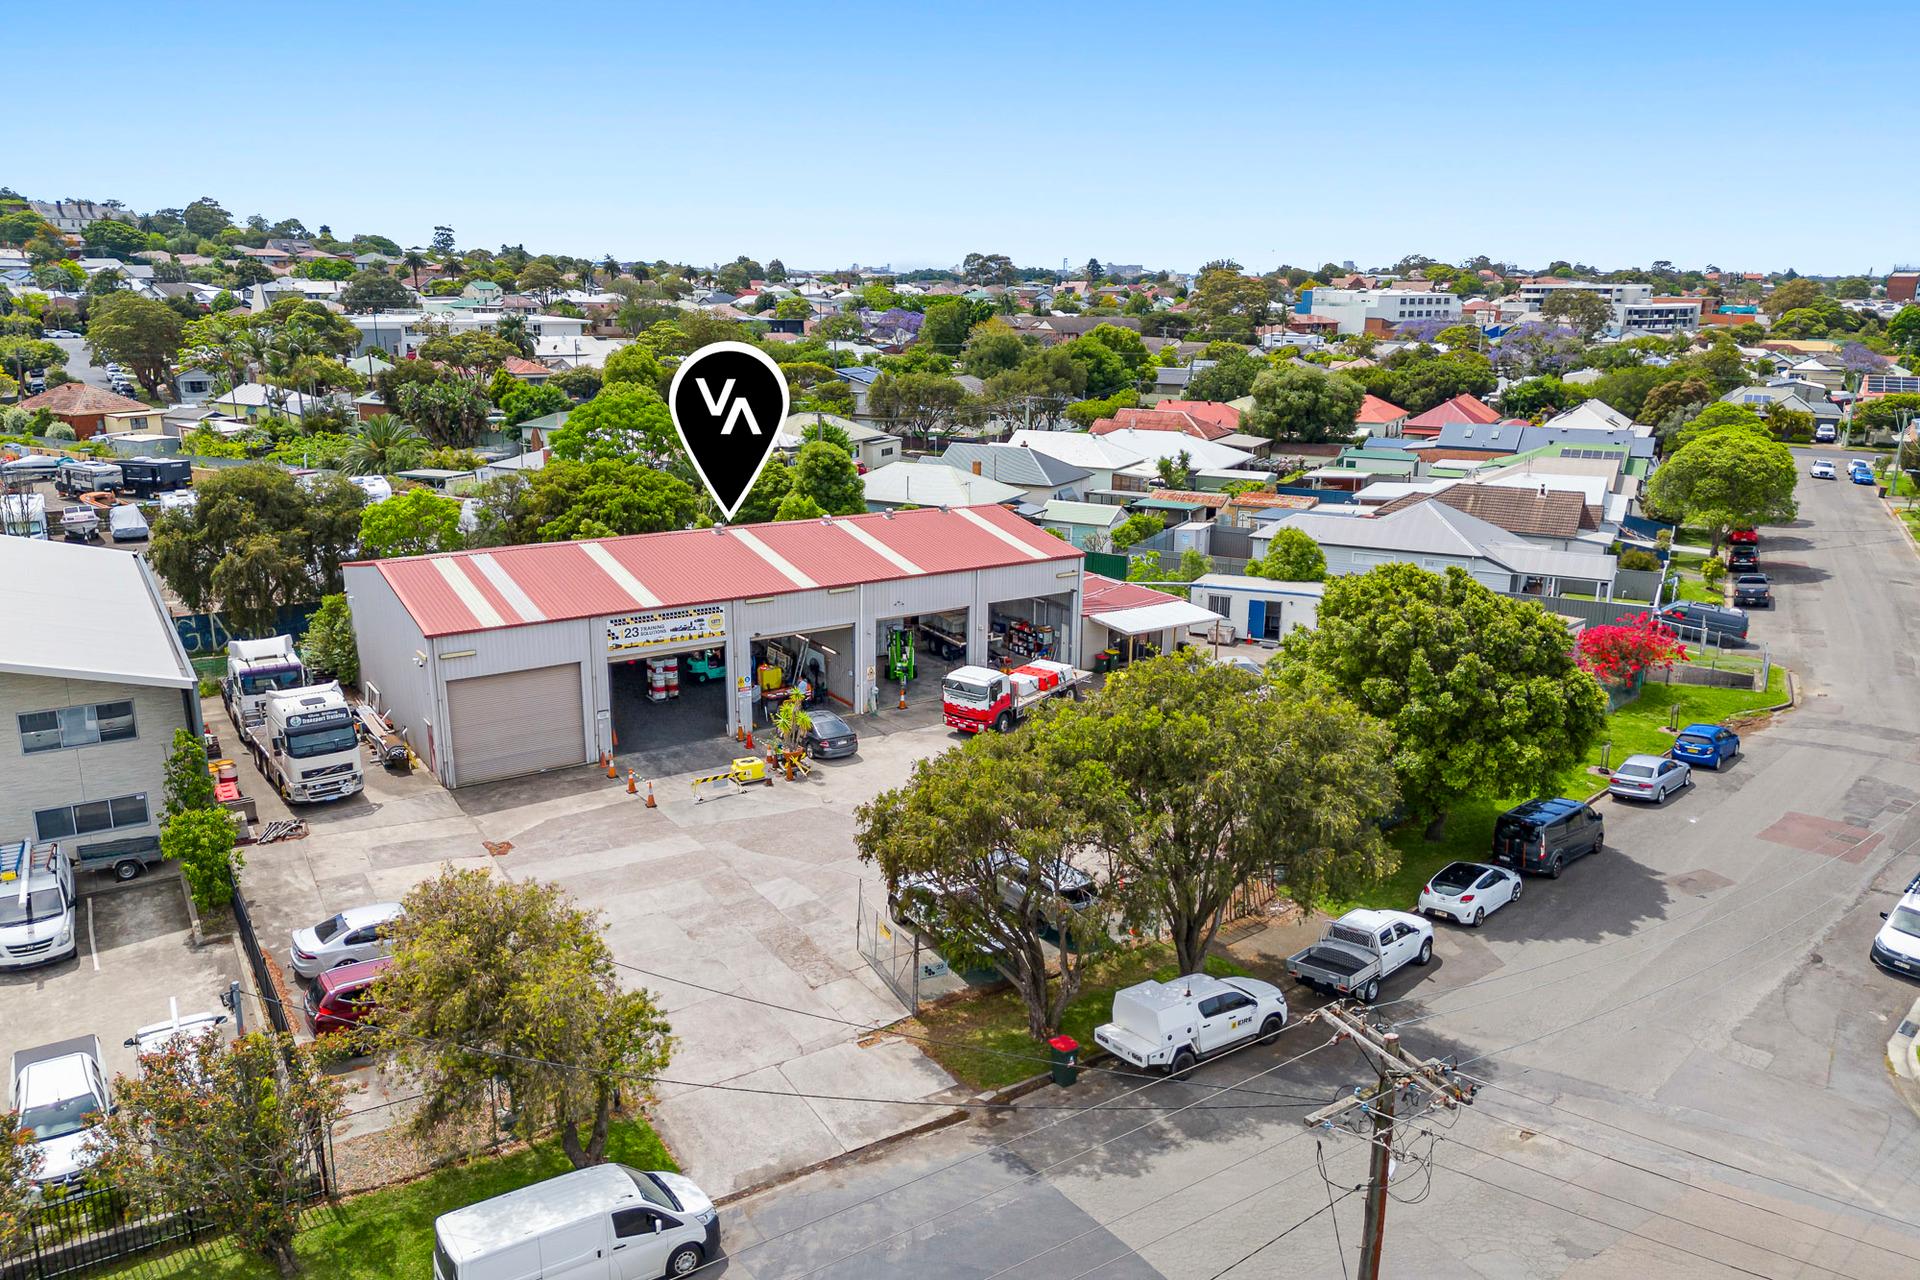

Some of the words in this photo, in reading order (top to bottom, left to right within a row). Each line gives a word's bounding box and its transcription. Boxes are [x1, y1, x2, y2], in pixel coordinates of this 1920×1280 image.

[620, 626, 640, 639] 123
[640, 624, 665, 632] TRAINING
[640, 629, 667, 637] SOLUTIONS
